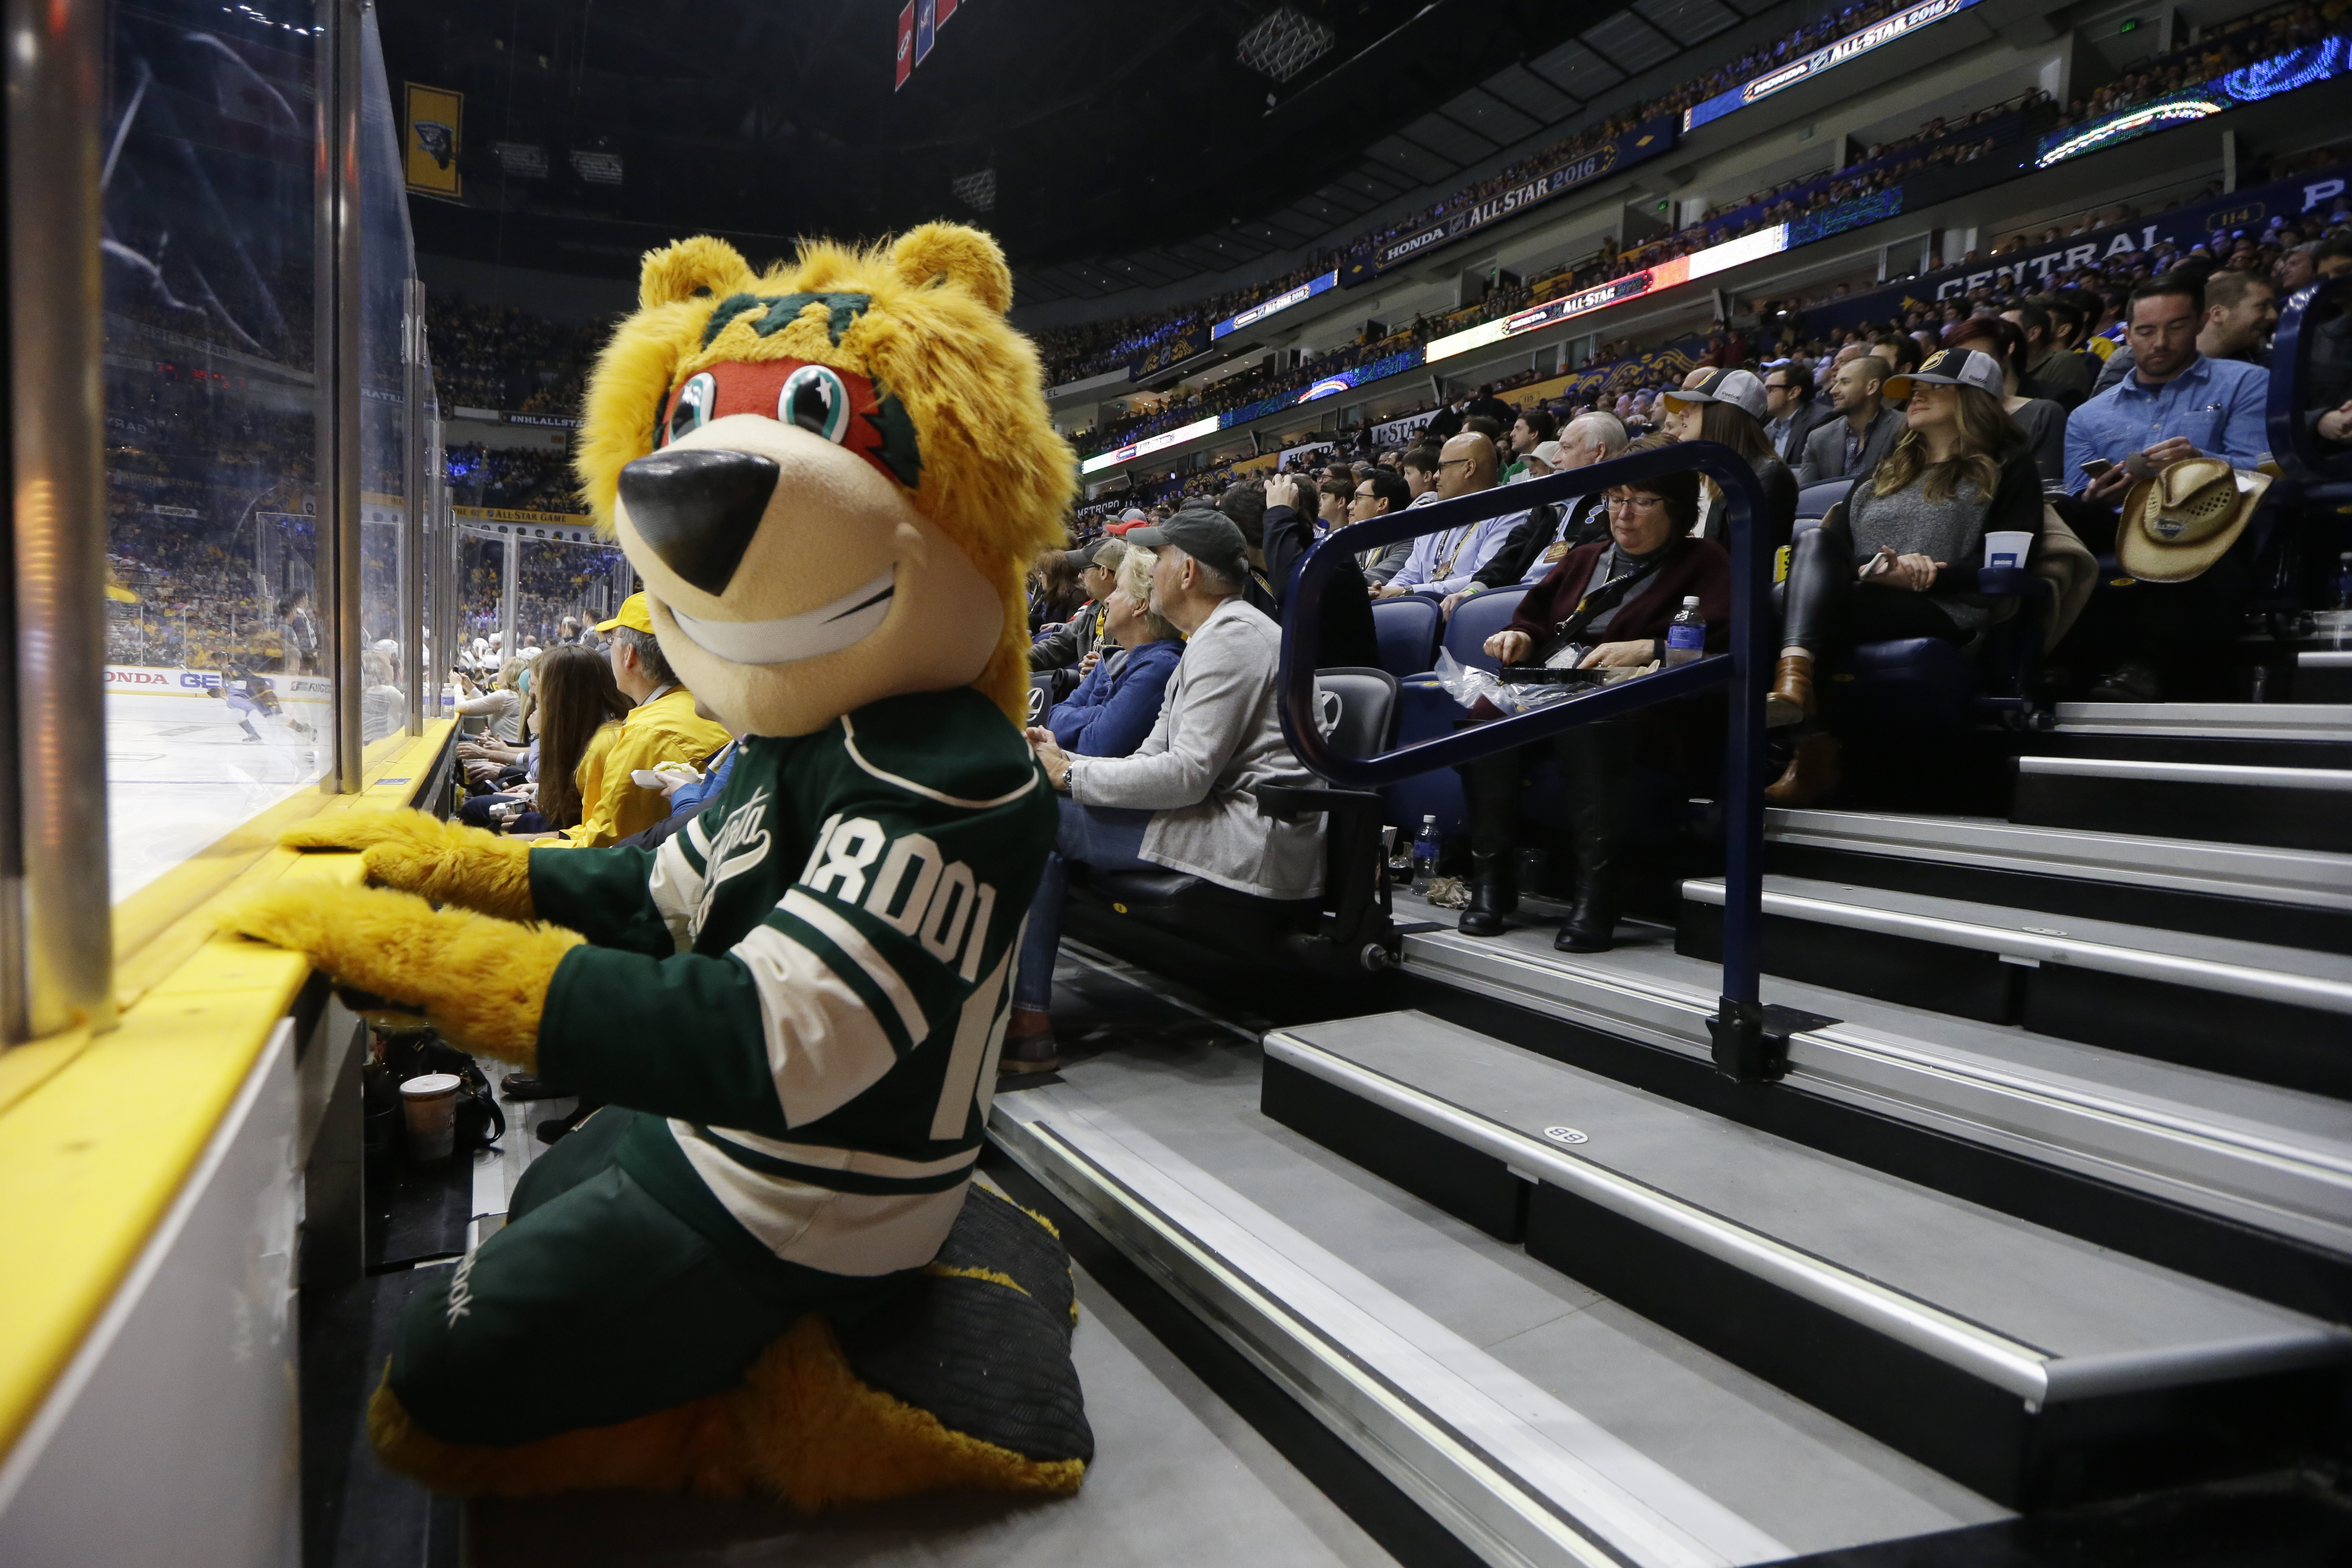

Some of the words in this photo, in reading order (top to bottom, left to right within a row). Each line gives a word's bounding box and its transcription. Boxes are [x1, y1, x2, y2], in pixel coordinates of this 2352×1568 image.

[1754, 64, 1808, 94] HONDA
[1908, 0, 1945, 26] 2016
[1387, 228, 1445, 260] HONDA
[1553, 157, 1595, 189] 2016
[2221, 208, 2249, 227] 114
[1936, 225, 2174, 300] CENTRAL
[1722, 392, 1740, 401] Reebok
[511, 415, 583, 428] #NHLALLSTA
[540, 512, 566, 522] GAME
[103, 671, 170, 685] ONDA
[800, 813, 996, 983] 18001
